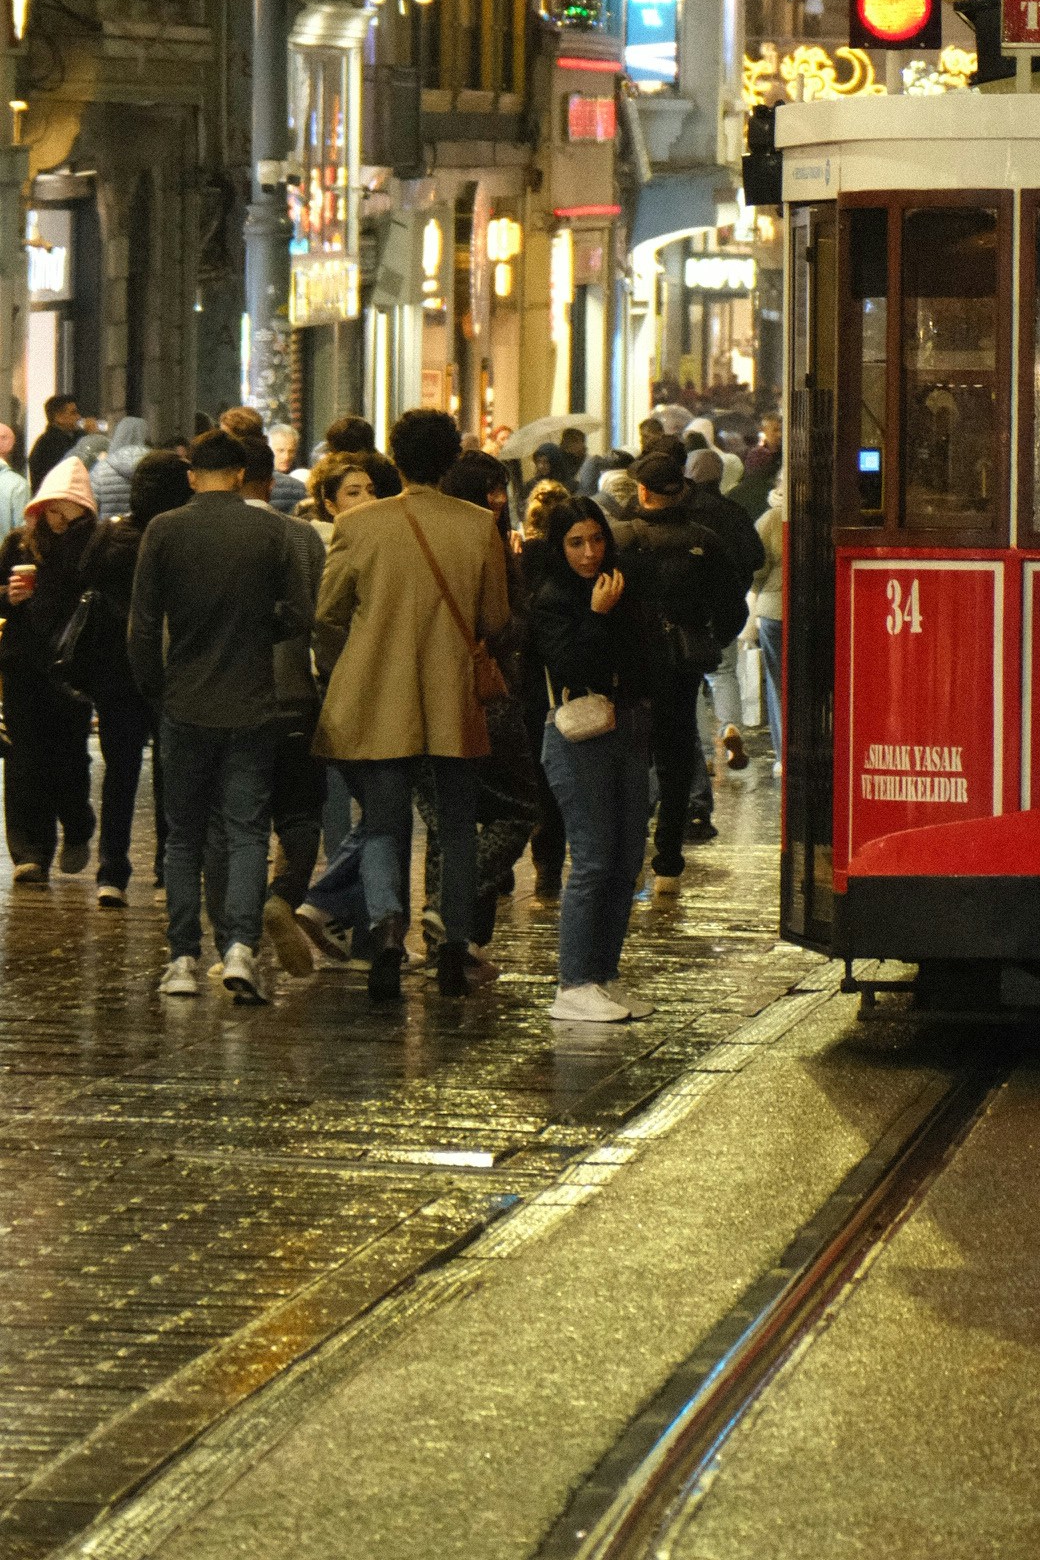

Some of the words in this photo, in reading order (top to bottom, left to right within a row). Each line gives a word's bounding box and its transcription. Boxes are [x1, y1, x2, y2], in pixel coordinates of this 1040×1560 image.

[886, 578, 923, 635] 34
[913, 746, 963, 772] YASAK
[861, 774, 872, 800] VE
